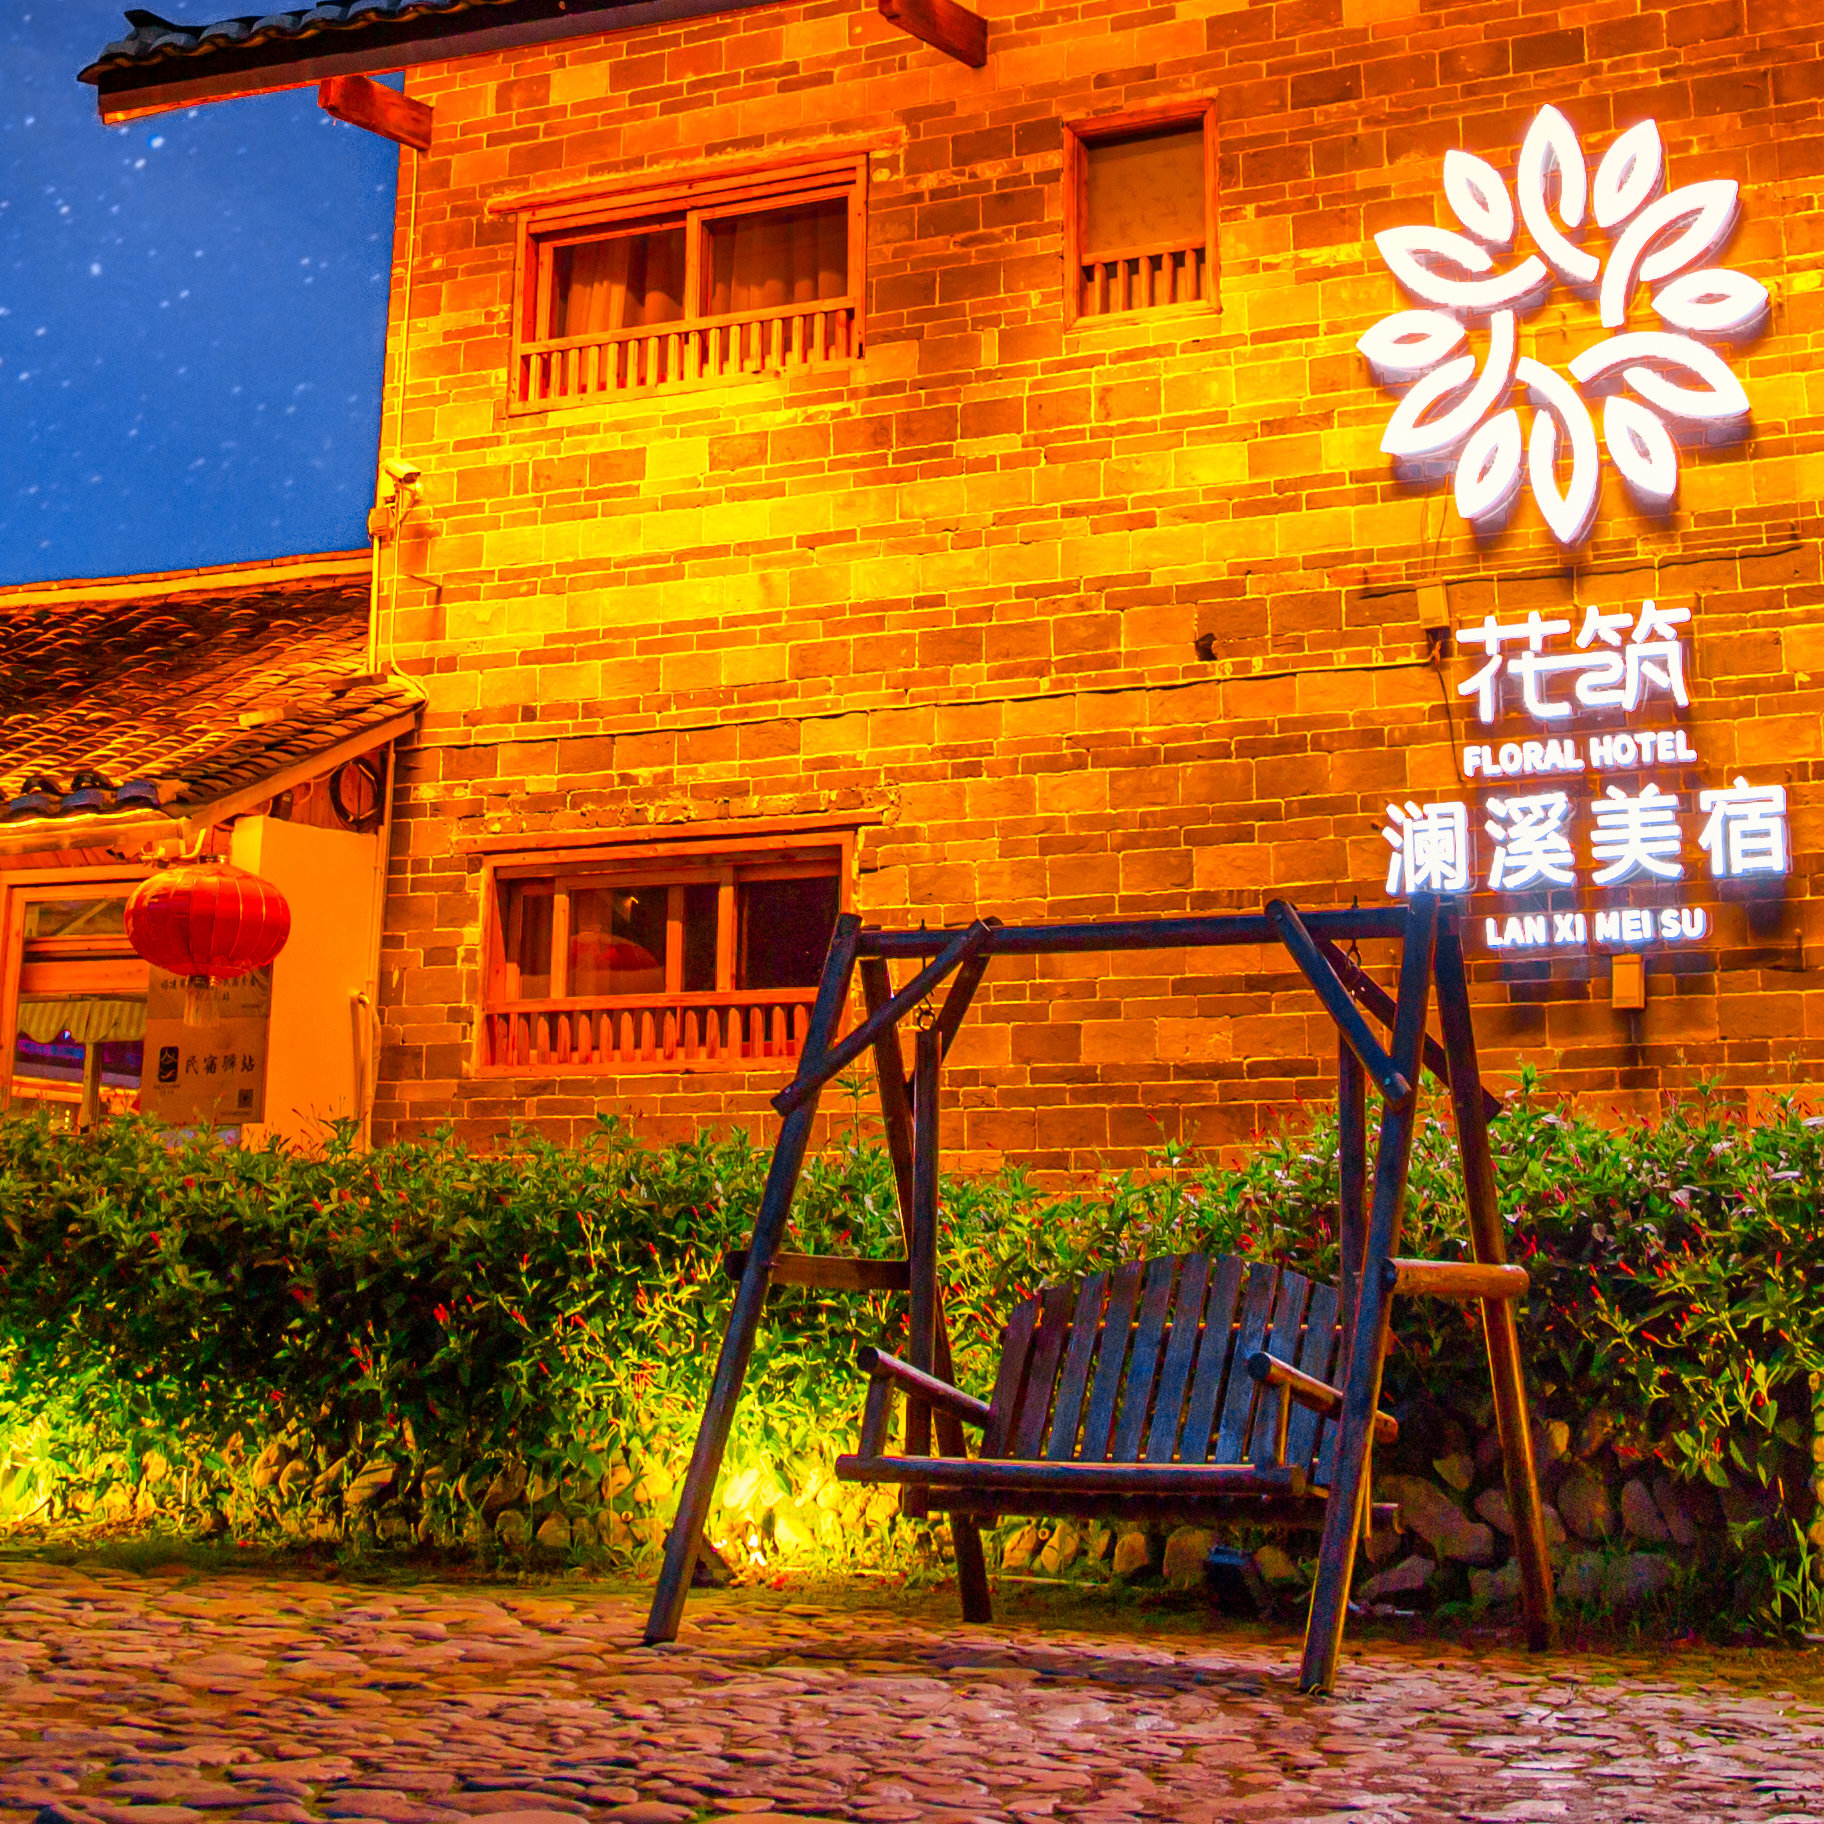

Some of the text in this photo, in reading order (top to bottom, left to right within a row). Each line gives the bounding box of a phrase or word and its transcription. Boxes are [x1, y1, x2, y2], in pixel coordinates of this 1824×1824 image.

[1456, 600, 1692, 724] 花筑
[1463, 730, 1698, 778] FLORAL HOTEL
[1381, 776, 1788, 897] 澜溪美宿
[1485, 907, 1707, 949] LAN XI MEI SU
